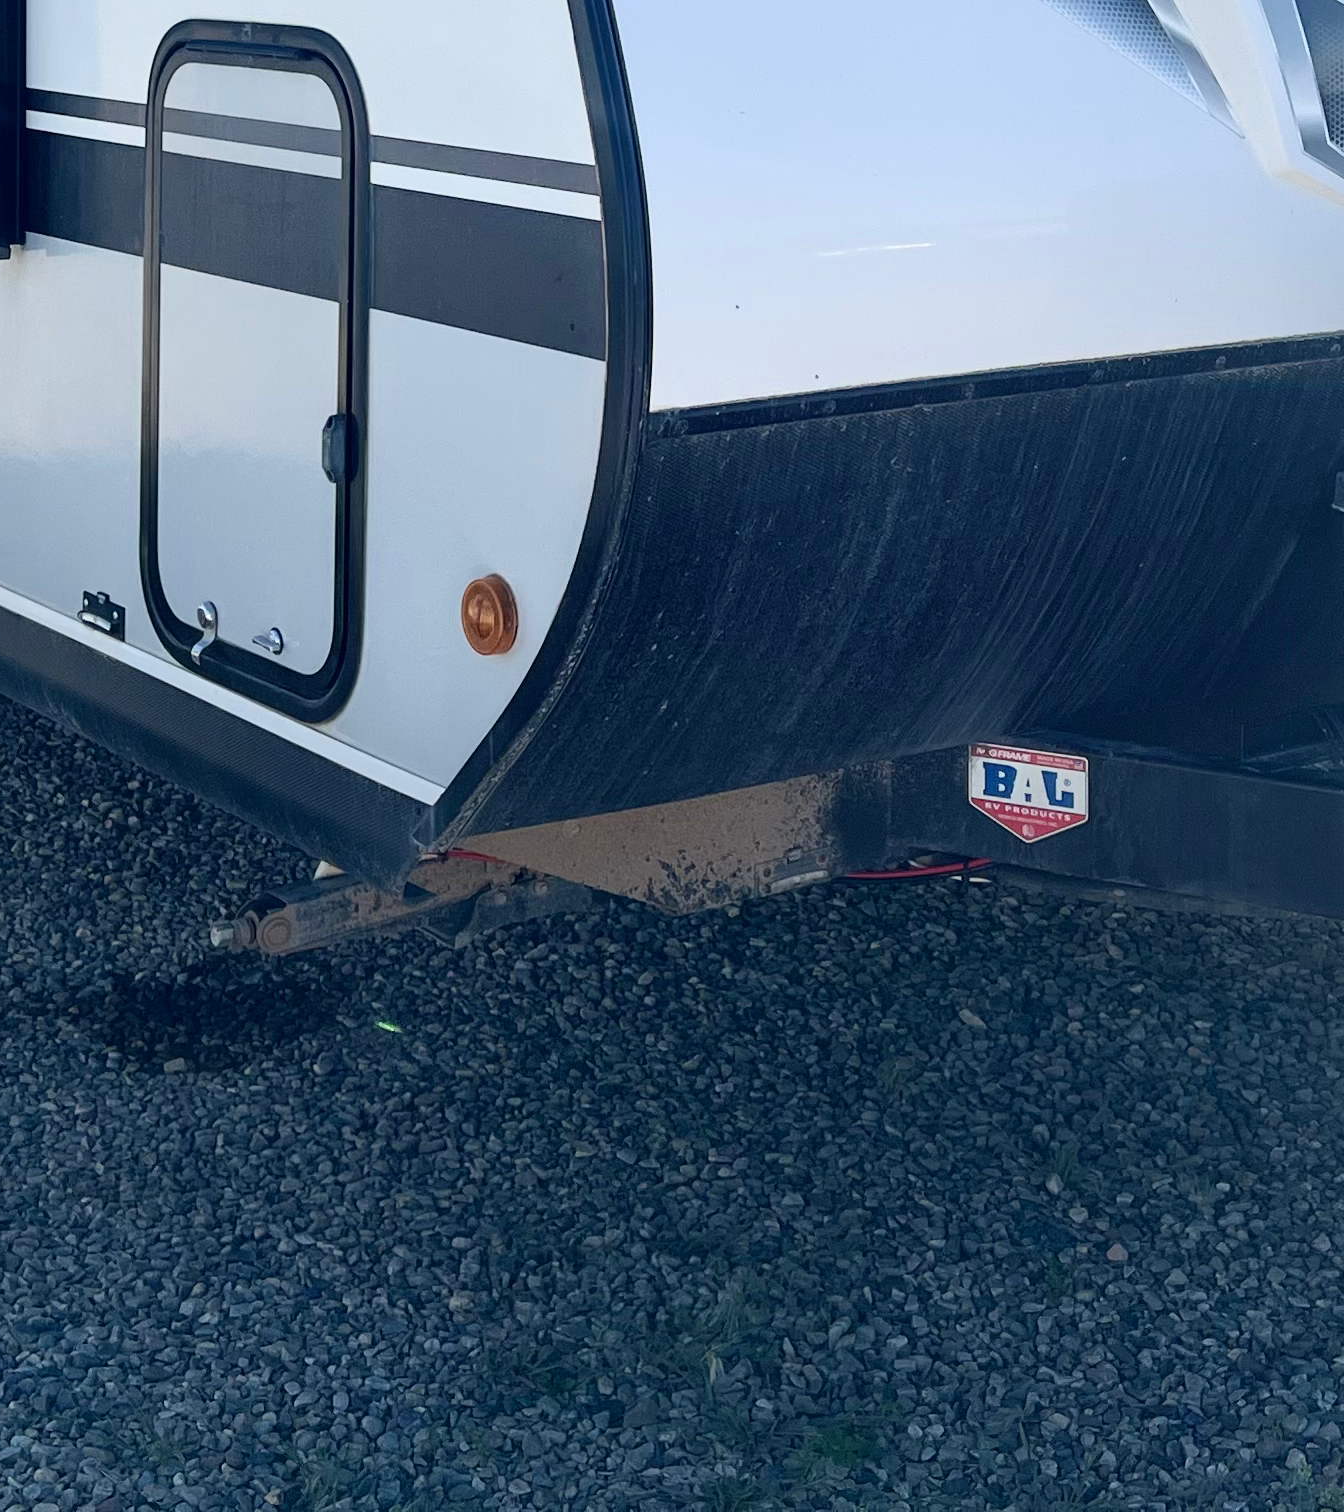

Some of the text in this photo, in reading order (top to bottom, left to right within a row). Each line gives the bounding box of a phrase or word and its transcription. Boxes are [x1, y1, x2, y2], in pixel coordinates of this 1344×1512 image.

[982, 761, 1075, 809] BAL
[984, 801, 1001, 811] RV
[1004, 804, 1071, 822] PRODUCTS
